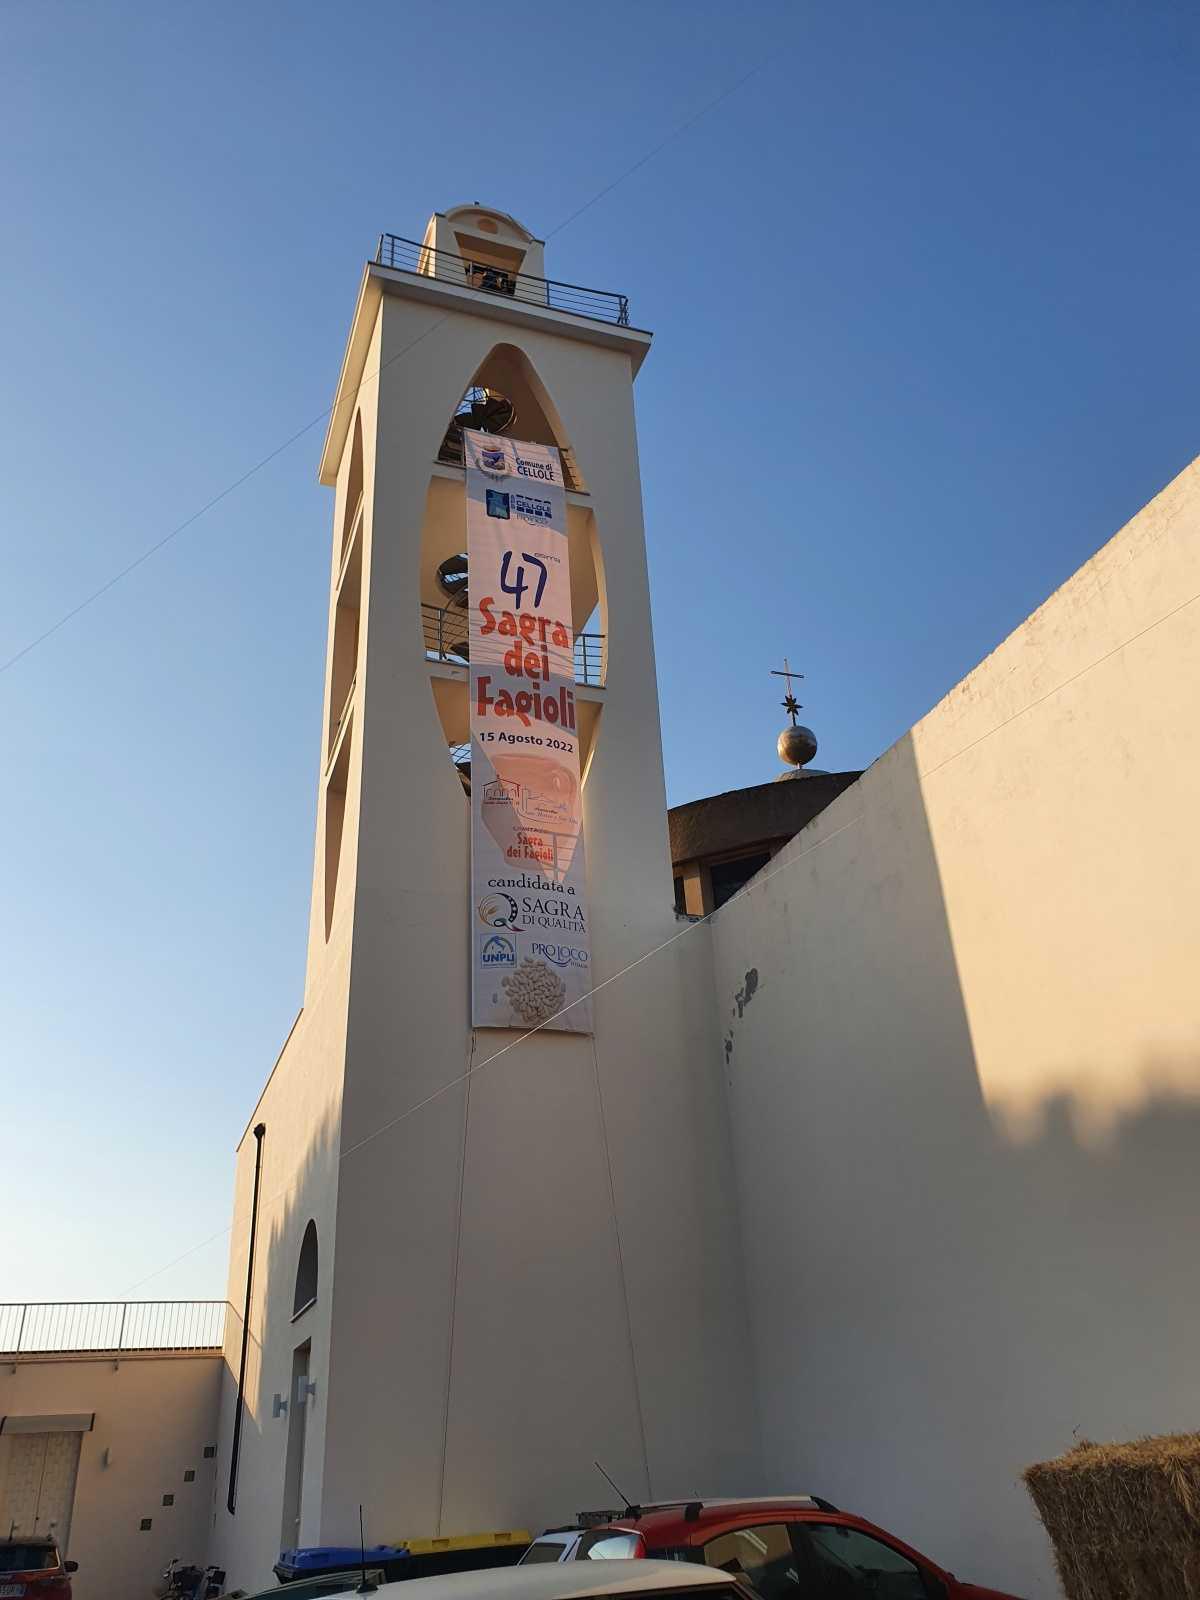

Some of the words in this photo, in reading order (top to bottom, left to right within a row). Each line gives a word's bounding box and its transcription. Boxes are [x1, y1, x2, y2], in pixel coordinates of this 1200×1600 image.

[516, 457, 544, 470] Comune
[545, 463, 553, 471] di
[516, 466, 556, 481] CELLOLE
[516, 501, 551, 512] CELLOLE
[501, 550, 548, 609] 47
[479, 596, 569, 649] Sagra
[504, 640, 550, 682] dei
[477, 676, 576, 730] Fagioli
[479, 732, 494, 742] 15
[498, 731, 543, 746] Agosto
[546, 738, 574, 754] 2022
[516, 832, 543, 848] Sagra
[506, 846, 521, 858] dei
[523, 846, 554, 862] Fagioli
[488, 873, 564, 892] candidata
[567, 886, 576, 895] a
[522, 897, 585, 921] SAGRA
[522, 914, 535, 925] DI
[537, 916, 586, 934] QUALITÀ
